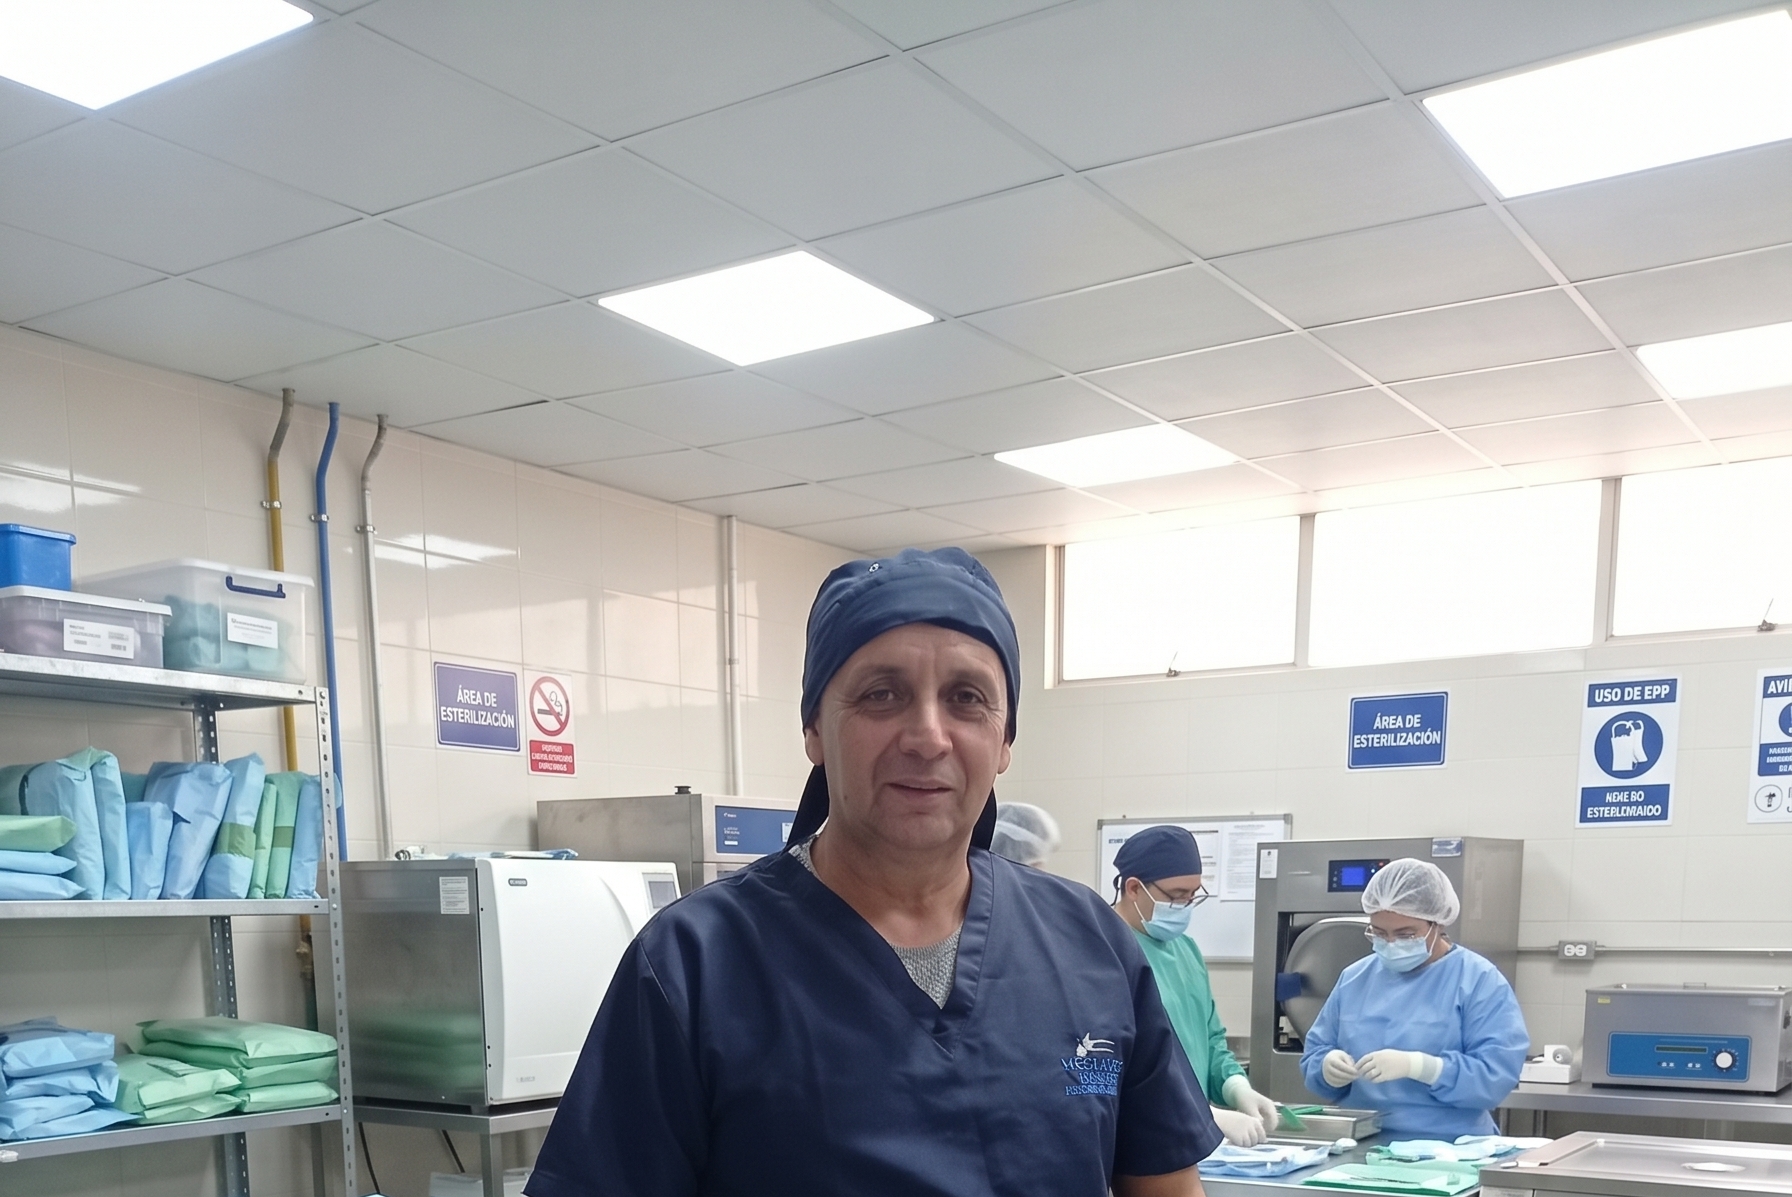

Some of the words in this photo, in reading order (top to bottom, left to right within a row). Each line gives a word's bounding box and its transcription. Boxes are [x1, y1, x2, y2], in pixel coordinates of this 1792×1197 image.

[457, 685, 482, 705] ÁREA
[484, 692, 497, 707] DE
[1594, 688, 1621, 702] USO
[1624, 686, 1642, 701] DE
[1644, 684, 1670, 699] EPP
[440, 707, 515, 728] ESTERILIZACIÓN
[1373, 712, 1403, 730] ÁREA
[1405, 714, 1421, 728] DE
[1353, 728, 1441, 748] ESTERILIZACIÓN
